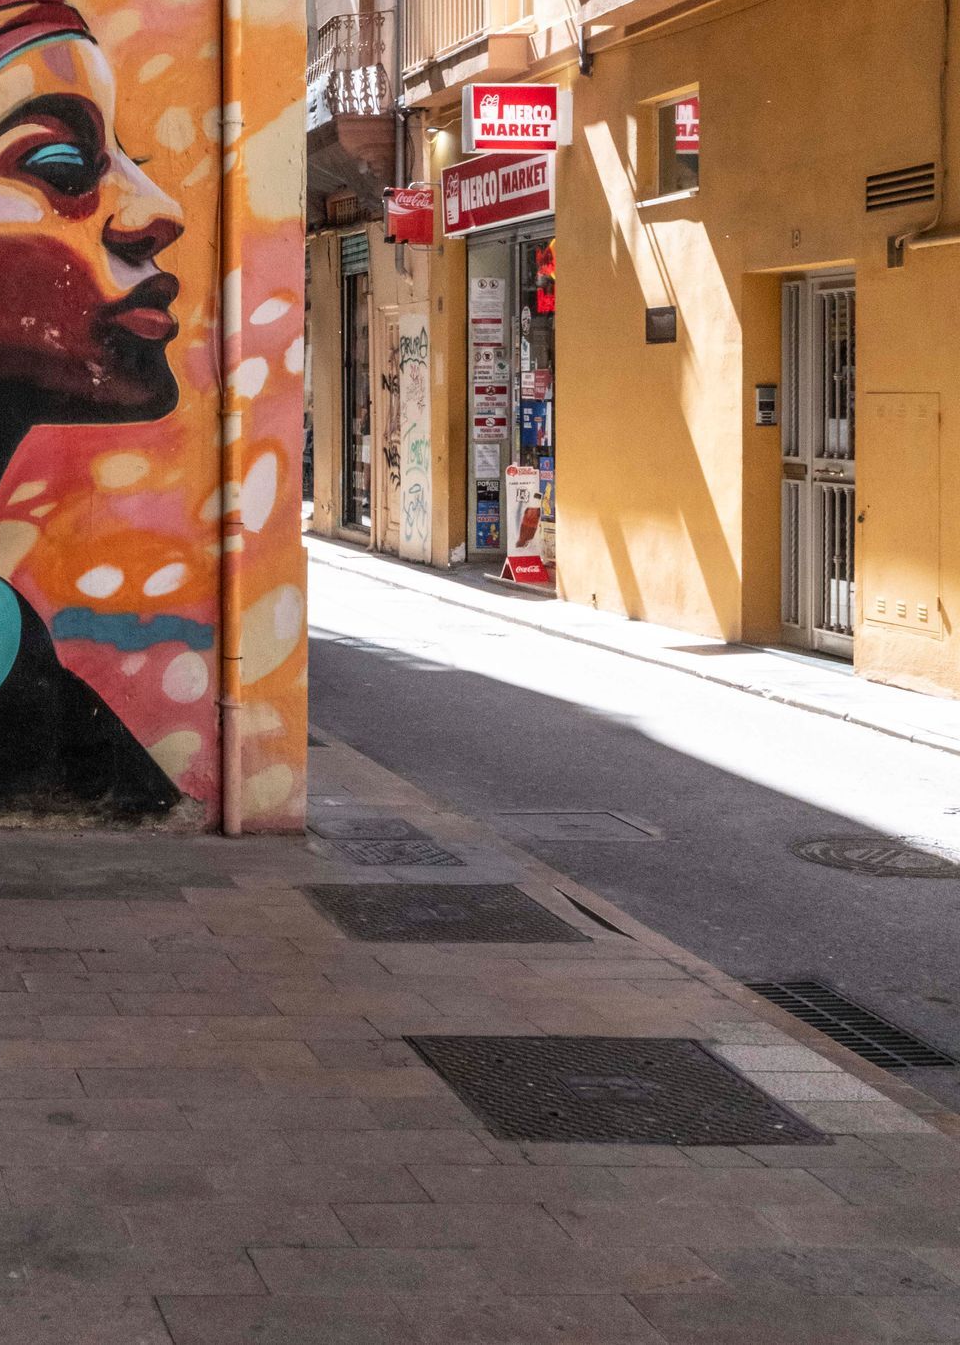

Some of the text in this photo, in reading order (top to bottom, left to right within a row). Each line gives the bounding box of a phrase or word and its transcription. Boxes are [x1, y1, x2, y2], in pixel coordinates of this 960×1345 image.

[503, 104, 552, 120] MERCO
[481, 123, 551, 137] MARKET
[460, 162, 547, 212] MERCO MARKET
